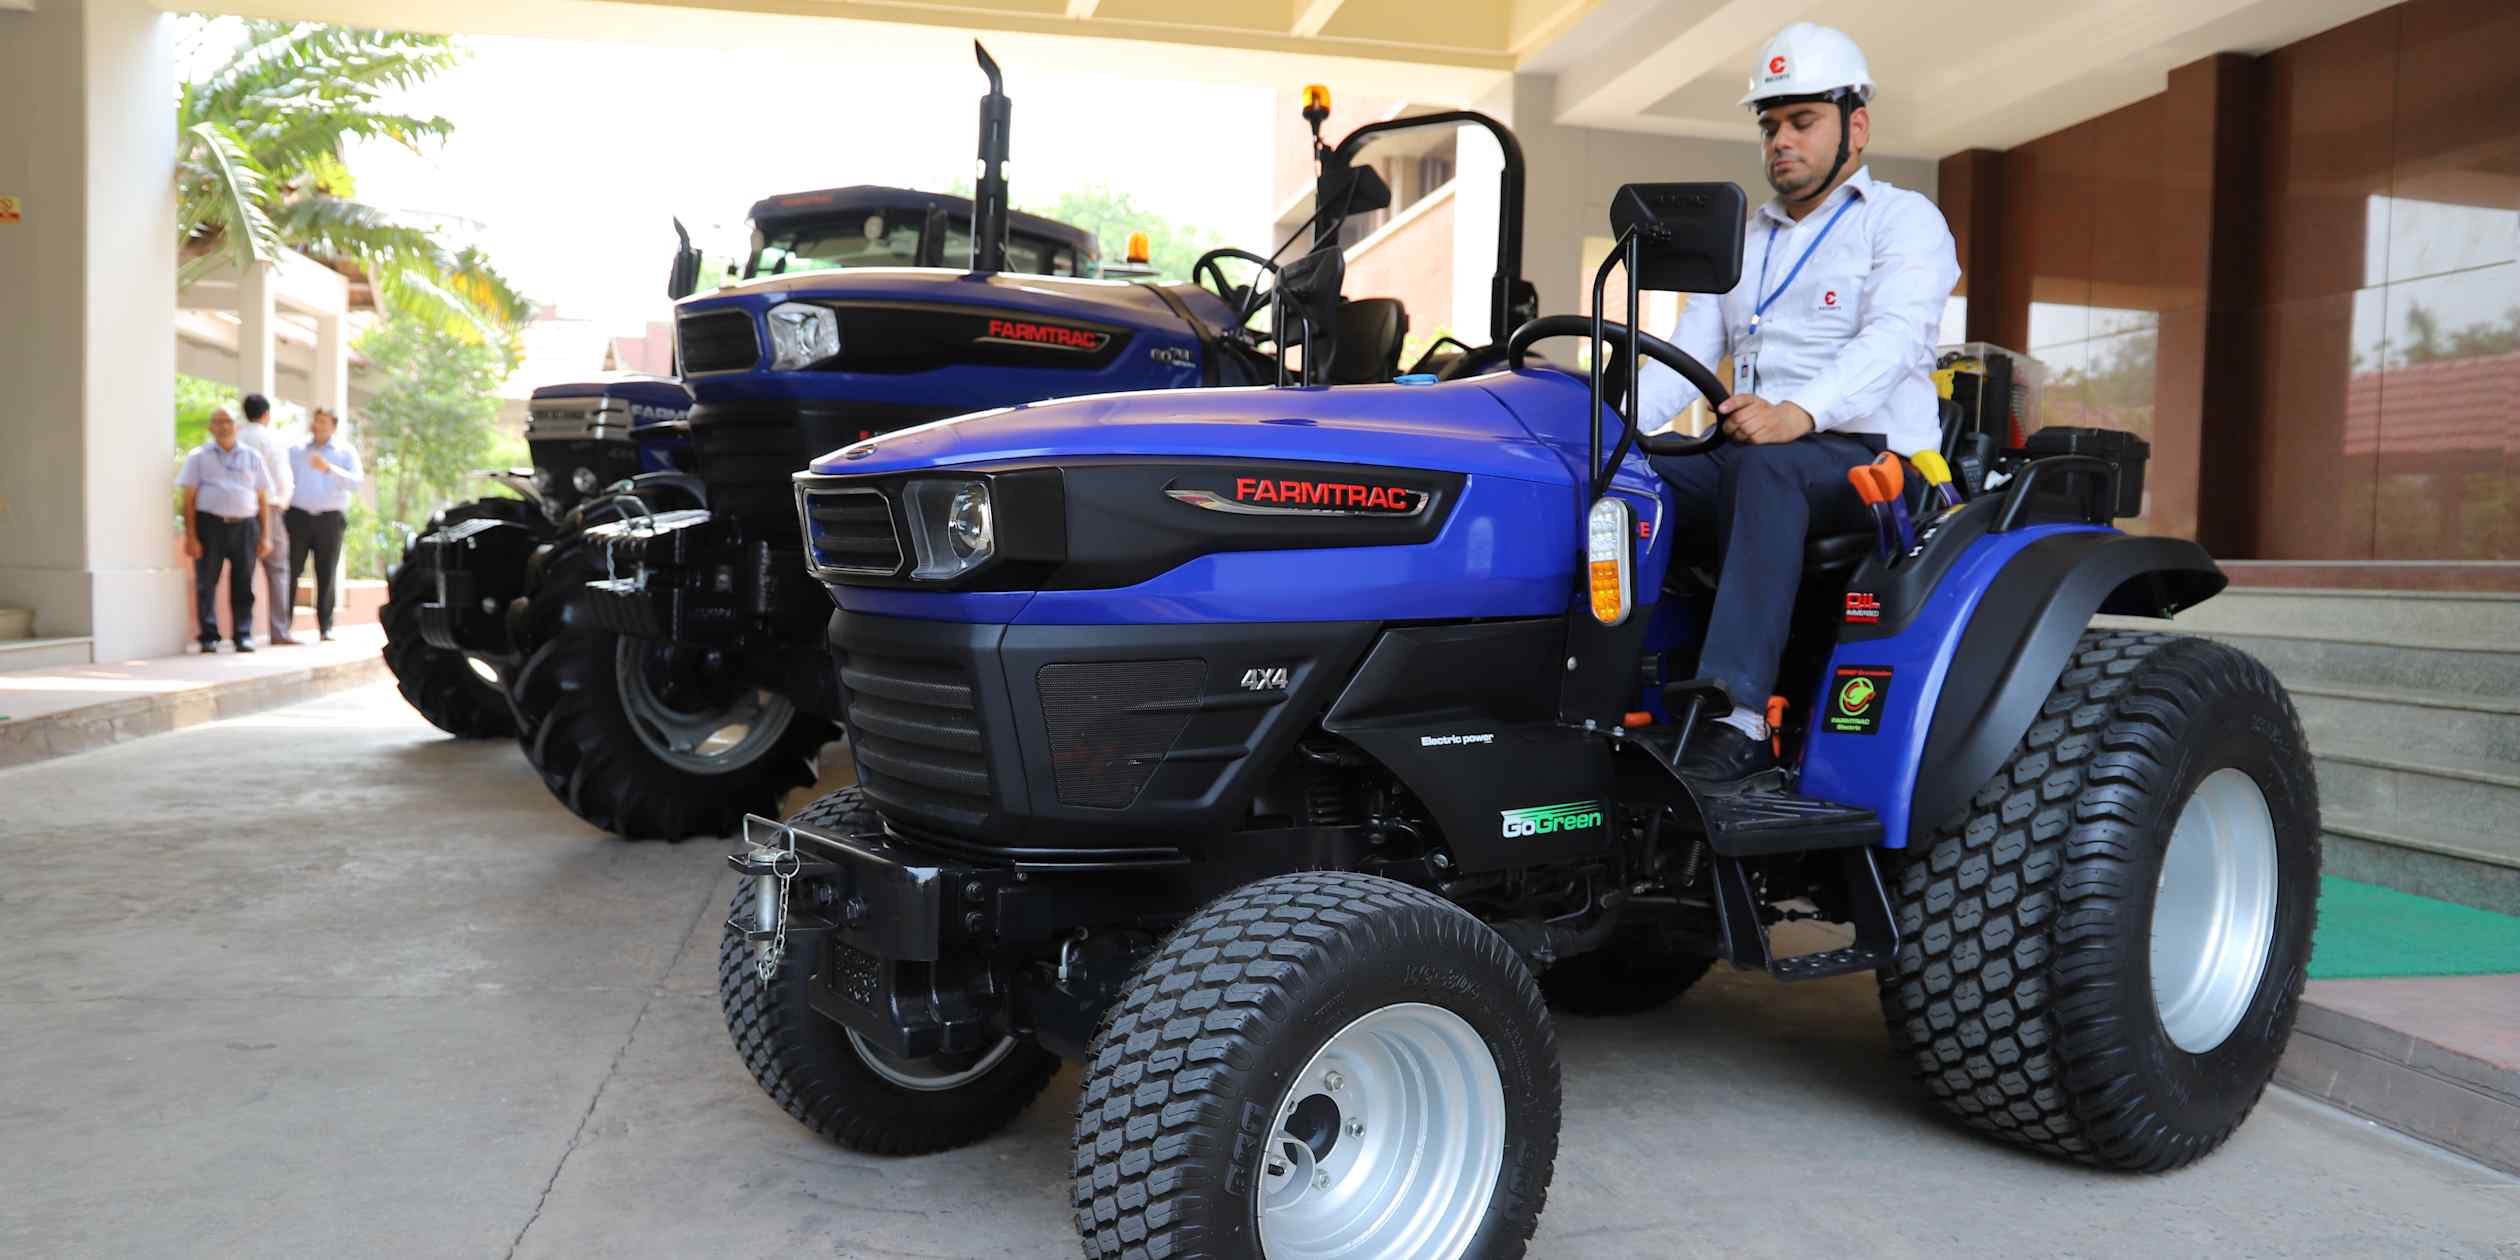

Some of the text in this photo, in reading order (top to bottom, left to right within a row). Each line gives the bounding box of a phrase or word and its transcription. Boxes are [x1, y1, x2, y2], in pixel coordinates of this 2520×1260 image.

[988, 319, 1098, 349] FARMTRAC
[631, 403, 690, 419] FARM
[1234, 477, 1409, 511] FARMTRAC
[1240, 667, 1289, 691] 4X4
[1420, 732, 1494, 747] Electric power
[1502, 811, 1602, 839] GoGreen
